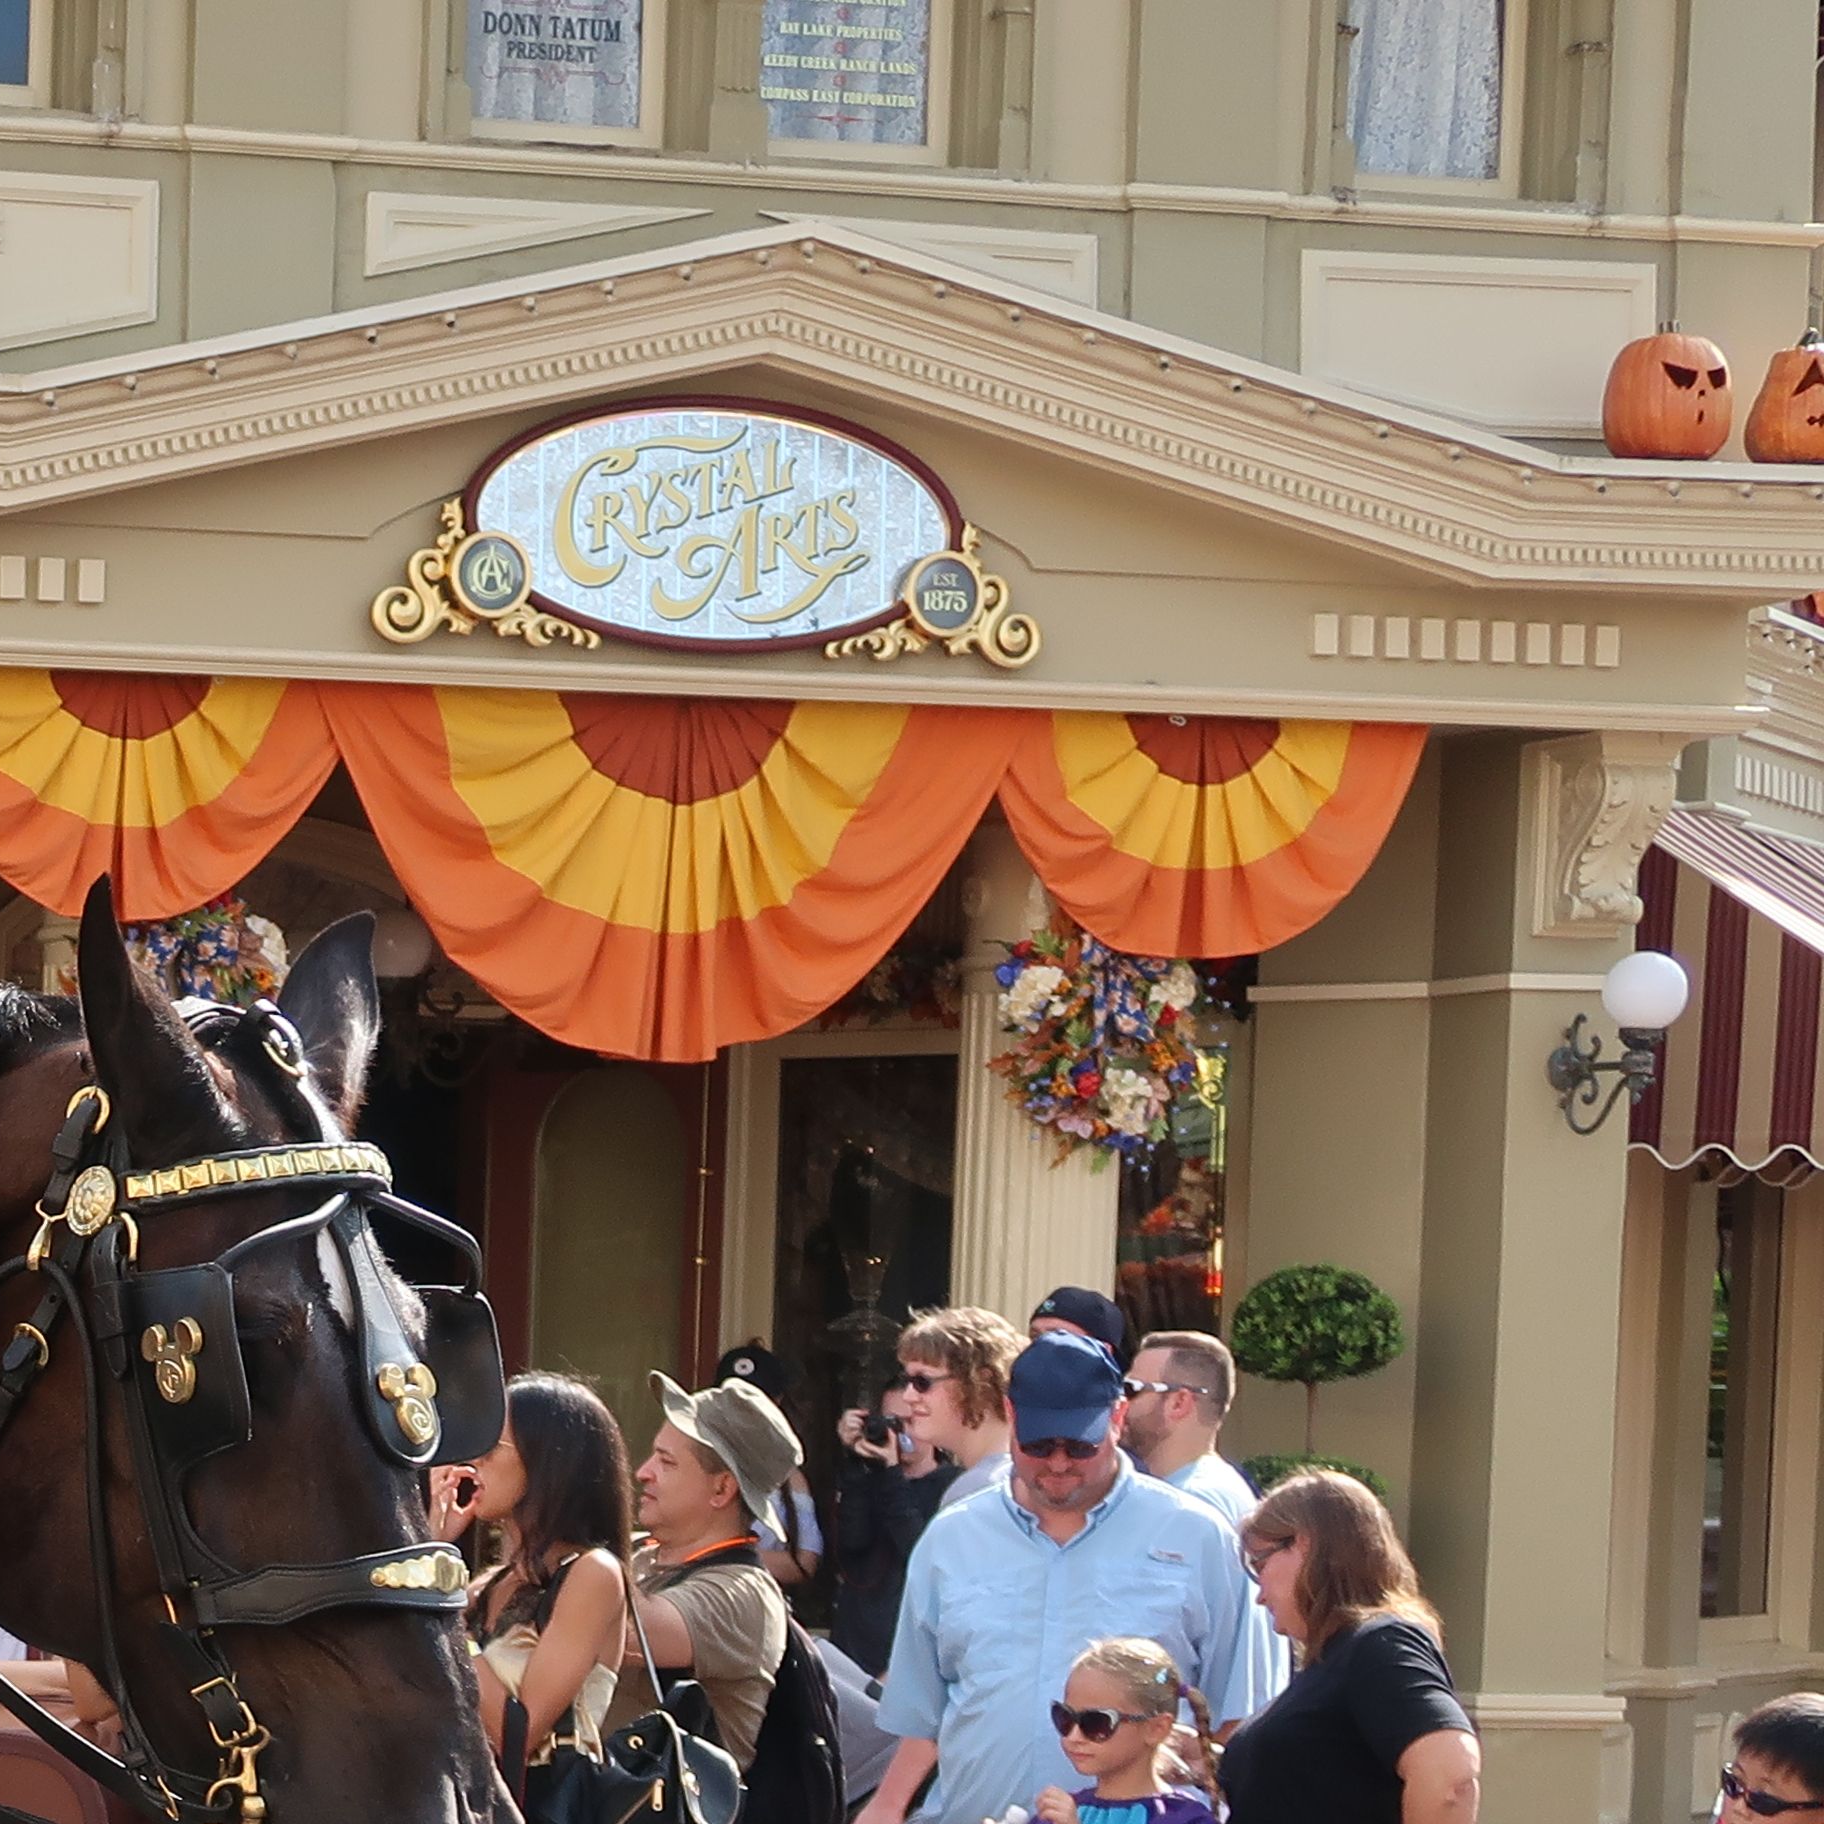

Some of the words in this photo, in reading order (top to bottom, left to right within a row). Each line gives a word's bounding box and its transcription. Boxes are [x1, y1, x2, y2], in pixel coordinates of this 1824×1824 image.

[483, 10, 543, 38] DONN
[549, 16, 623, 43] TATUM
[803, 23, 833, 38] LAKE
[836, 25, 903, 42] PROPERTIES
[506, 41, 598, 64] PRESIDENT
[801, 55, 837, 70] CREEK
[840, 58, 877, 73] RANCH
[880, 61, 917, 75] LANDS
[760, 86, 809, 101] COMPASS
[811, 89, 840, 103] EAST
[842, 91, 917, 108] CORPORATION
[555, 424, 798, 588] CRYSTAL
[650, 489, 871, 625] ARTS
[923, 589, 968, 613] 1875
